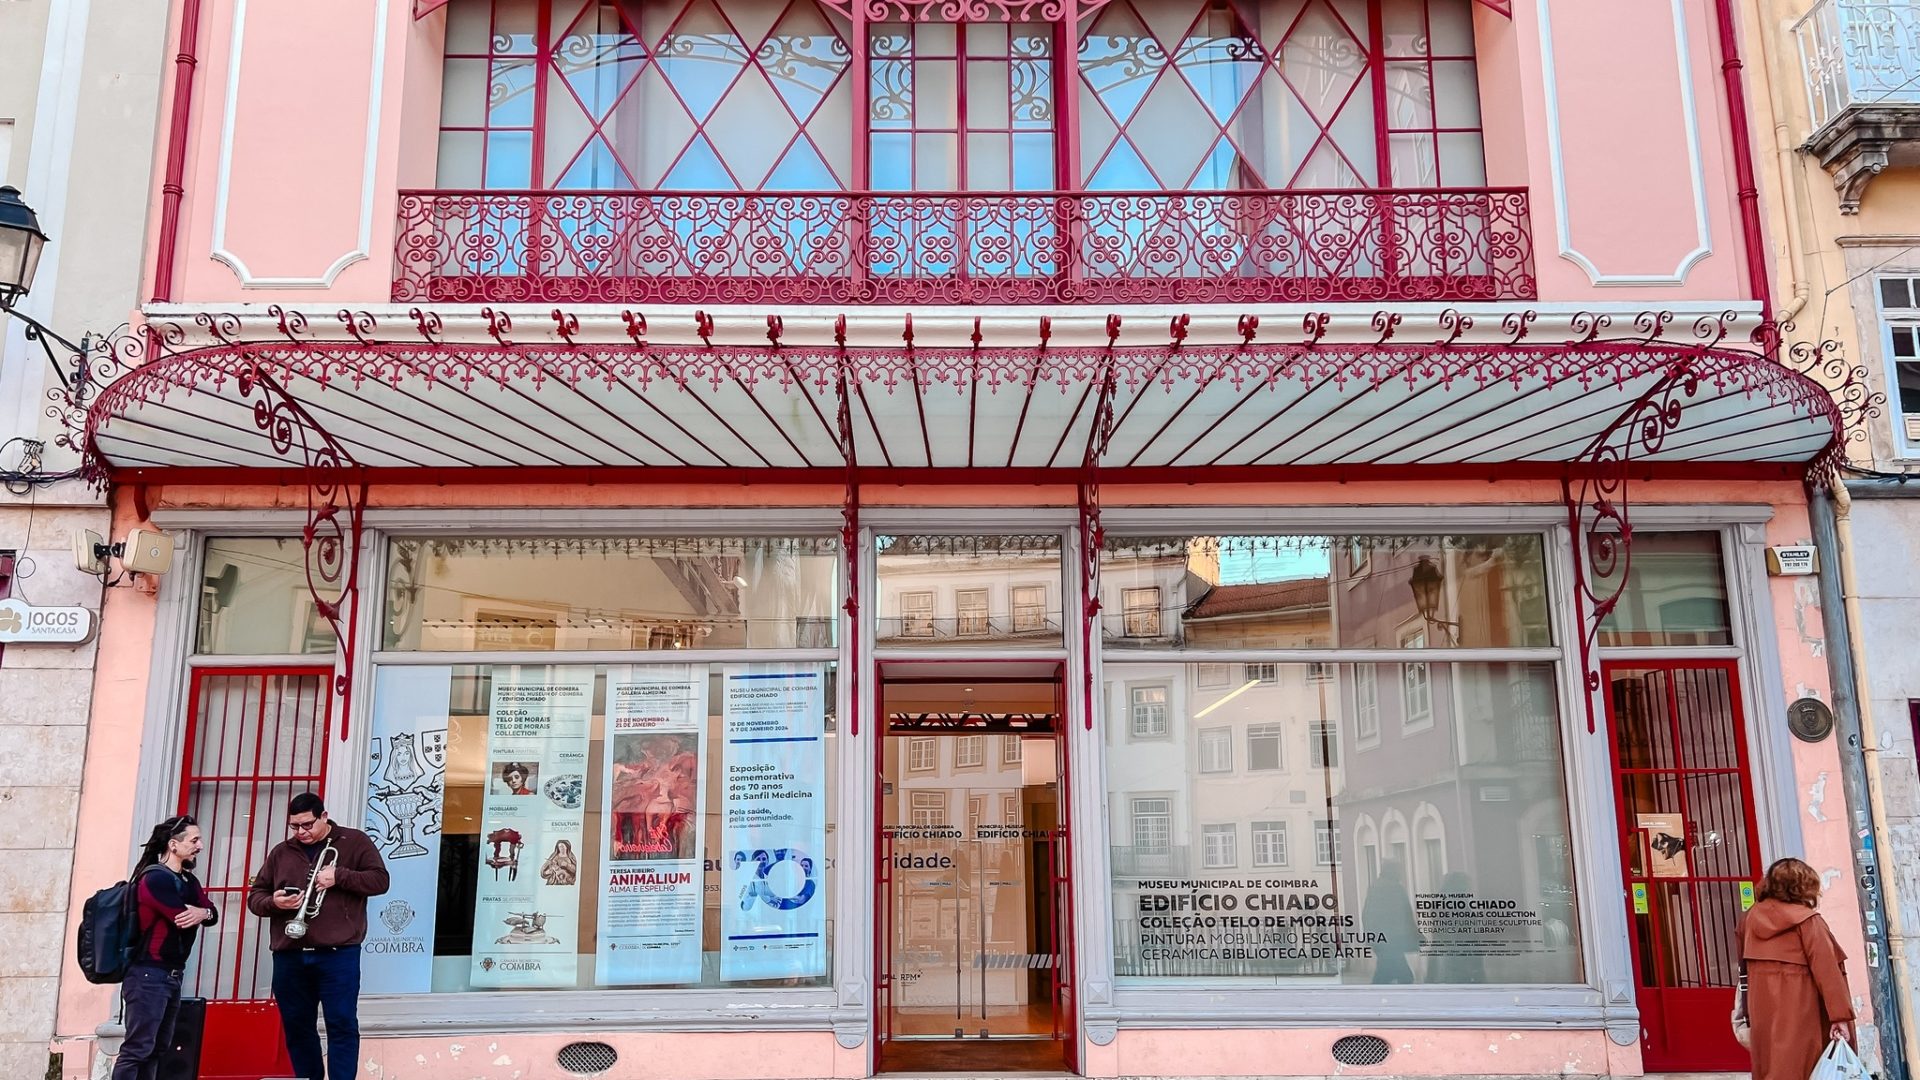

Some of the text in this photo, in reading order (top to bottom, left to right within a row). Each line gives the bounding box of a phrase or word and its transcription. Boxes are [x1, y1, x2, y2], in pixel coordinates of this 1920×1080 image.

[26, 611, 78, 630] JOGOS
[729, 764, 776, 773] Exposição
[729, 772, 795, 782] comemorativa
[748, 783, 759, 791] 70
[743, 791, 770, 800] Sanfil
[771, 790, 813, 799] Medicina
[729, 808, 746, 816] Pela
[746, 814, 794, 822] comunidade.
[922, 830, 962, 839] CHIADO
[977, 829, 1019, 838] EDIFÍCIO
[609, 873, 691, 885] ANIMALIUM
[1138, 879, 1319, 889] MUSEU MUNICIPAL DE COIMBRA
[1139, 889, 1338, 912] EDIFÍCIO CHIADO
[1416, 898, 1516, 910] EDIFÍCIO CHIADO
[1140, 913, 1354, 932] COLEÇÃO TELO DE MORAIS
[1141, 934, 1206, 945] PINTURA
[1303, 933, 1387, 944] ESCULTURA
[365, 942, 425, 953] COIMBRA
[1222, 948, 1308, 959] BIBLIOTECA
[1311, 947, 1331, 959] DE
[1334, 947, 1372, 959] ARTE
[499, 962, 541, 971] COIMBRA
